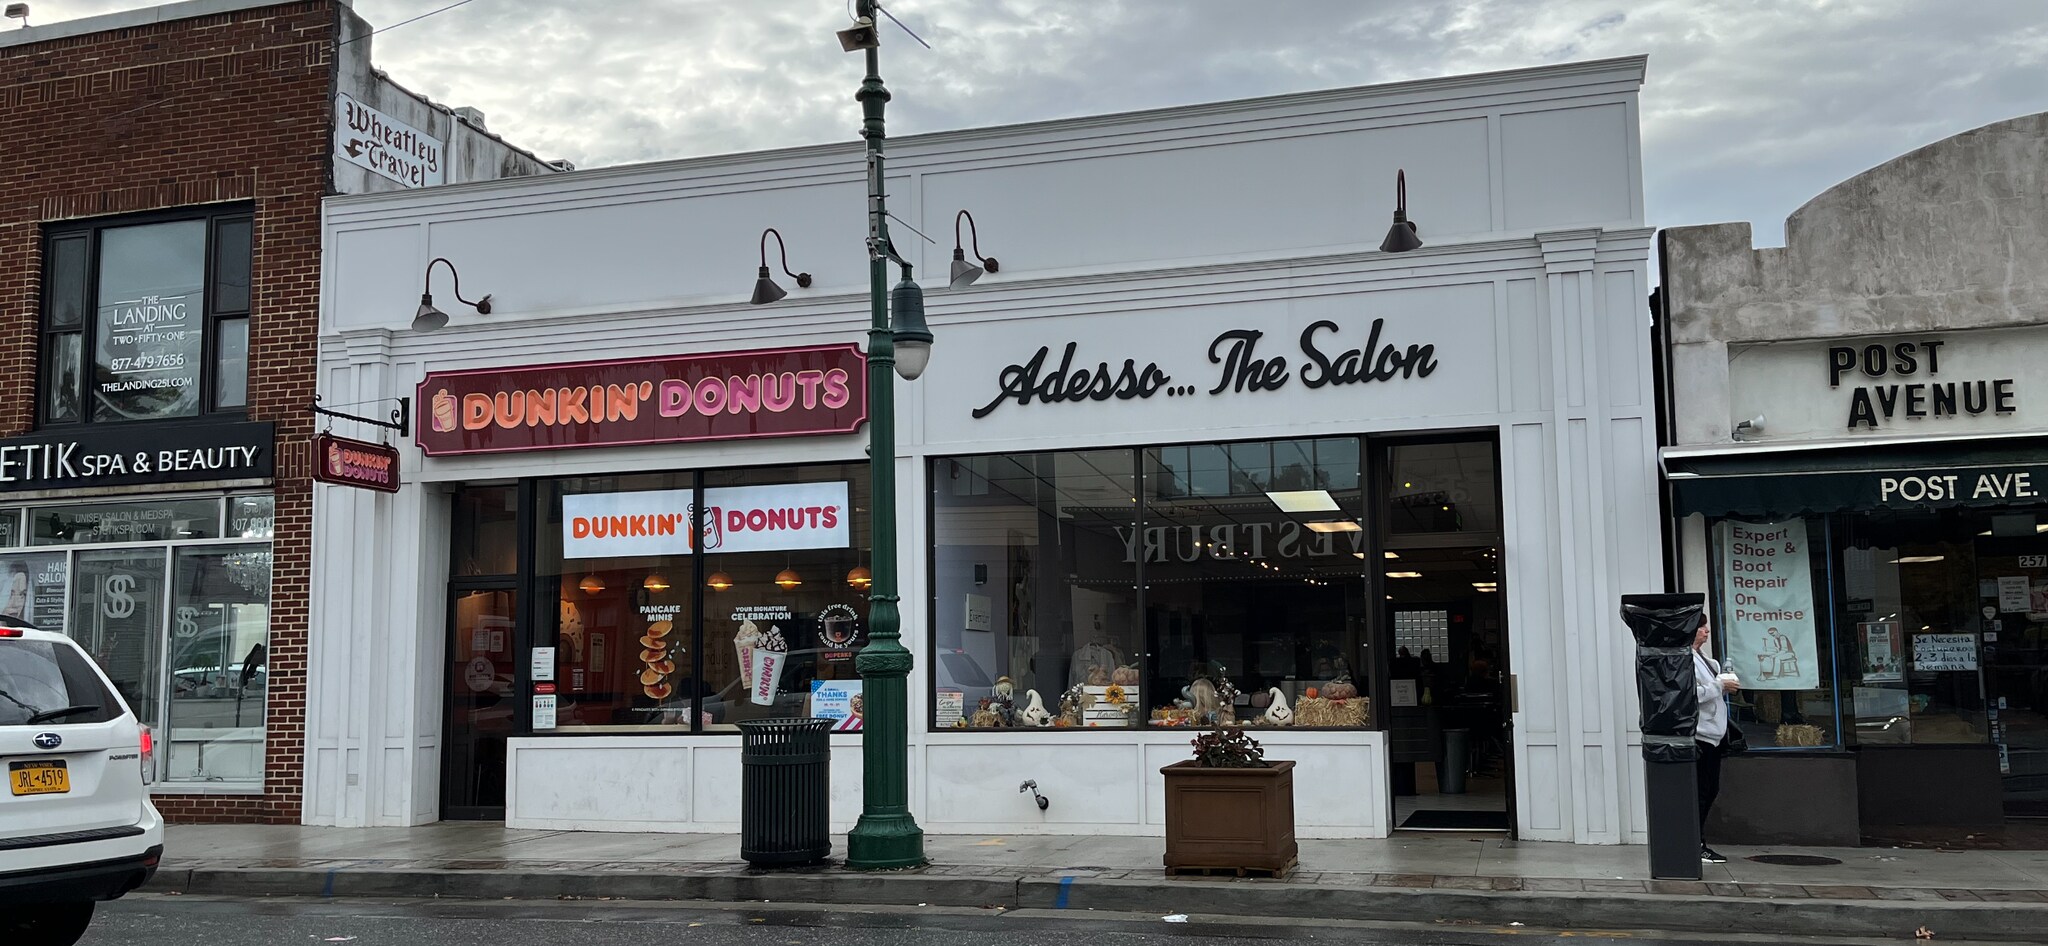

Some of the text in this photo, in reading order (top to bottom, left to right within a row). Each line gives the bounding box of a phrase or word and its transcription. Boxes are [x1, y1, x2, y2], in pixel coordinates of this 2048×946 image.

[346, 102, 437, 172] Wheatley
[364, 140, 424, 187] Travel
[142, 296, 160, 305] THE
[114, 304, 186, 325] LANDING
[144, 324, 155, 332] AT
[111, 354, 184, 370] 877-479-7656
[1208, 329, 1290, 395] The
[1300, 318, 1438, 388] Salon
[1828, 341, 1944, 388] POST
[462, 368, 850, 430] DUNKIN' DONUTS
[1848, 378, 2017, 429] AVENUE
[81, 454, 128, 477] SPA
[133, 452, 152, 474] &
[158, 446, 257, 472] BEAUTY
[343, 463, 389, 484] DONUTS
[1881, 472, 2039, 502] POST AVE.
[76, 509, 174, 524] UNISEX SALON & MEDSPA
[573, 506, 838, 539] DUNKIN' DONUTS
[1733, 527, 1788, 544] Expert
[1733, 542, 1796, 557] Shoe &
[1732, 560, 1772, 572] Boot
[2020, 556, 2045, 567] 257
[1733, 576, 1788, 591] Repair
[1735, 593, 1757, 605] On
[640, 605, 680, 613] PANCAKE
[731, 612, 791, 621] CELEBRATION
[818, 609, 828, 622] this
[842, 604, 858, 620] drink
[1736, 609, 1804, 621] Premise
[647, 614, 673, 622] MINIS
[818, 631, 834, 648] could
[844, 630, 859, 648] yours
[1915, 634, 1972, 644] Se Necesita
[1919, 662, 1966, 670] Semana
[18, 770, 63, 788] JRL 4519
